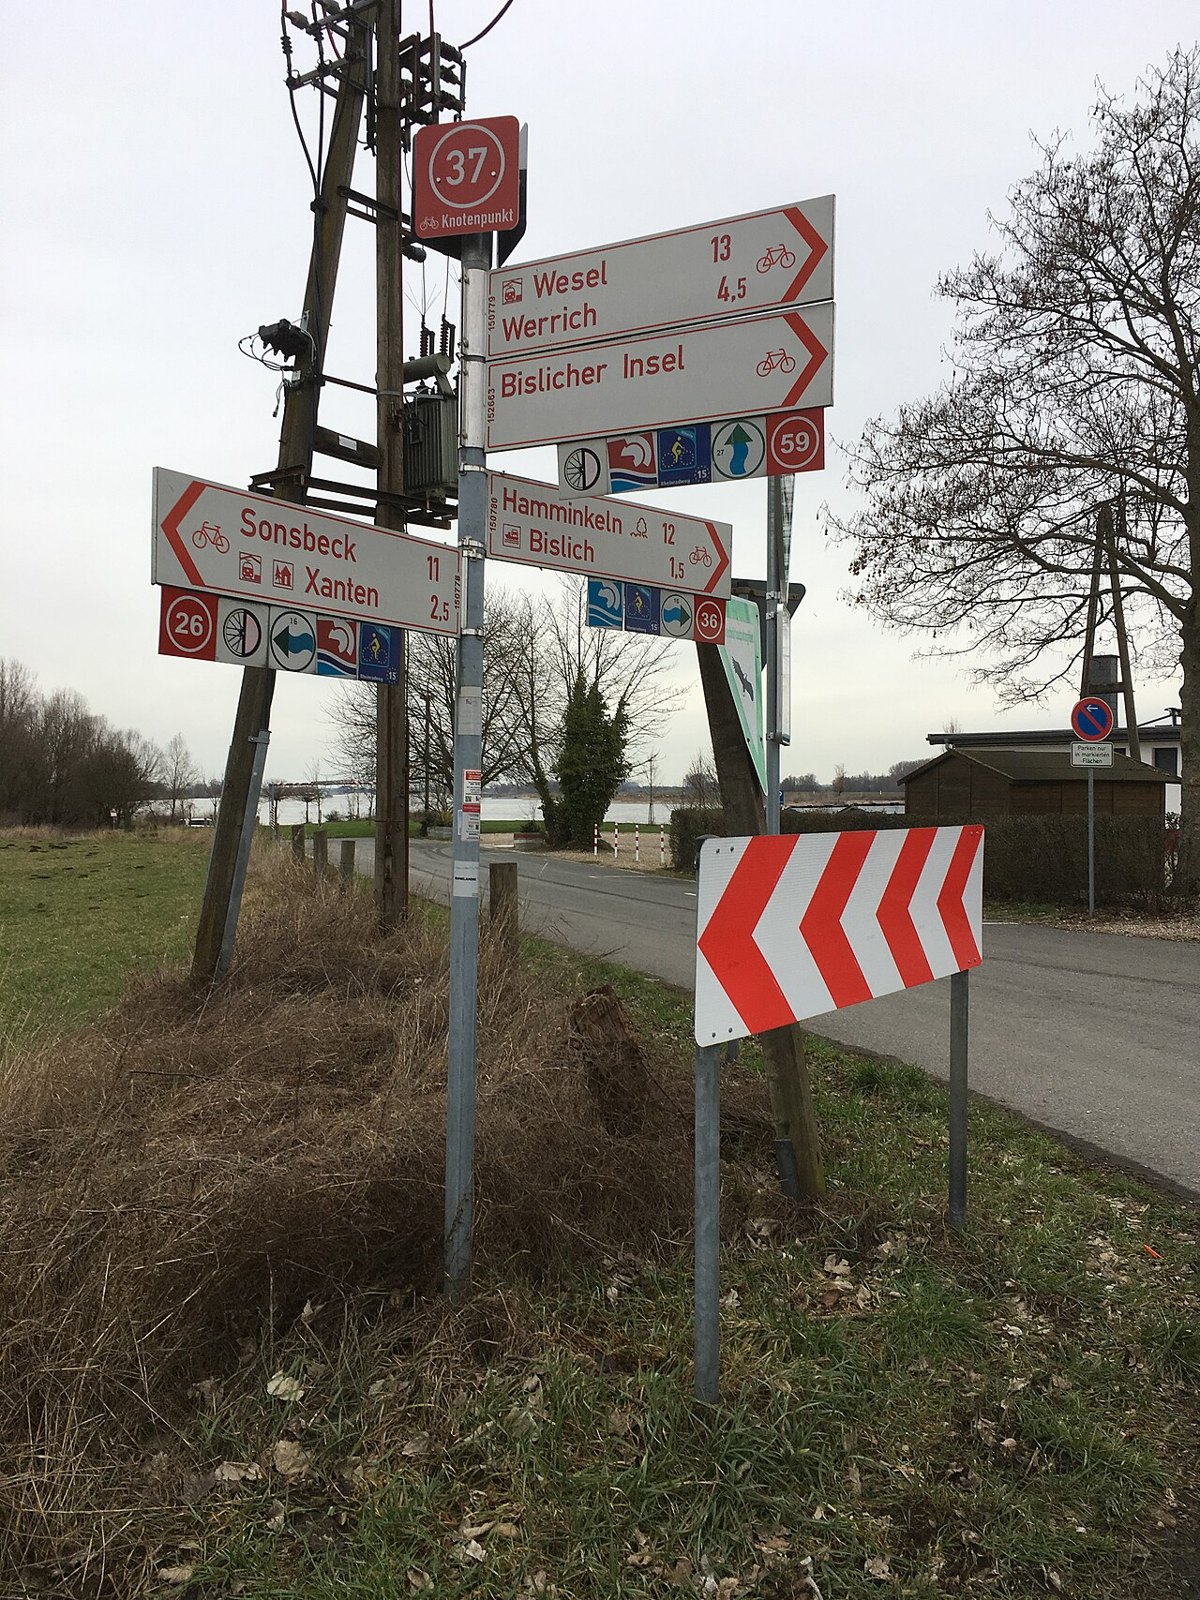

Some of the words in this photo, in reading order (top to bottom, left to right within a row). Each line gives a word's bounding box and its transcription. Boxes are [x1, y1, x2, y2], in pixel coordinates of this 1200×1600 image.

[446, 146, 488, 186] 37
[441, 208, 514, 229] Knotenpunkt
[533, 260, 607, 298] Wesel
[710, 234, 731, 263] 13
[502, 302, 597, 341] Werrich
[717, 275, 746, 302] 4,5
[501, 363, 607, 398] Bislicher
[623, 344, 685, 379] Insel
[487, 388, 495, 423] 152663
[780, 432, 809, 454] 59
[697, 469, 707, 479] 15
[503, 487, 622, 535] Hamminkeln
[662, 522, 675, 546] 12
[240, 507, 356, 562] Sonsbeck
[427, 555, 439, 582] 11
[529, 528, 594, 562] Bislich
[669, 556, 685, 579] 1,5
[304, 566, 379, 608] Xanten
[430, 595, 449, 622] 2,5
[174, 611, 204, 637] 26
[290, 617, 297, 625] 16
[701, 612, 718, 629] 36
[388, 671, 397, 681] 15
